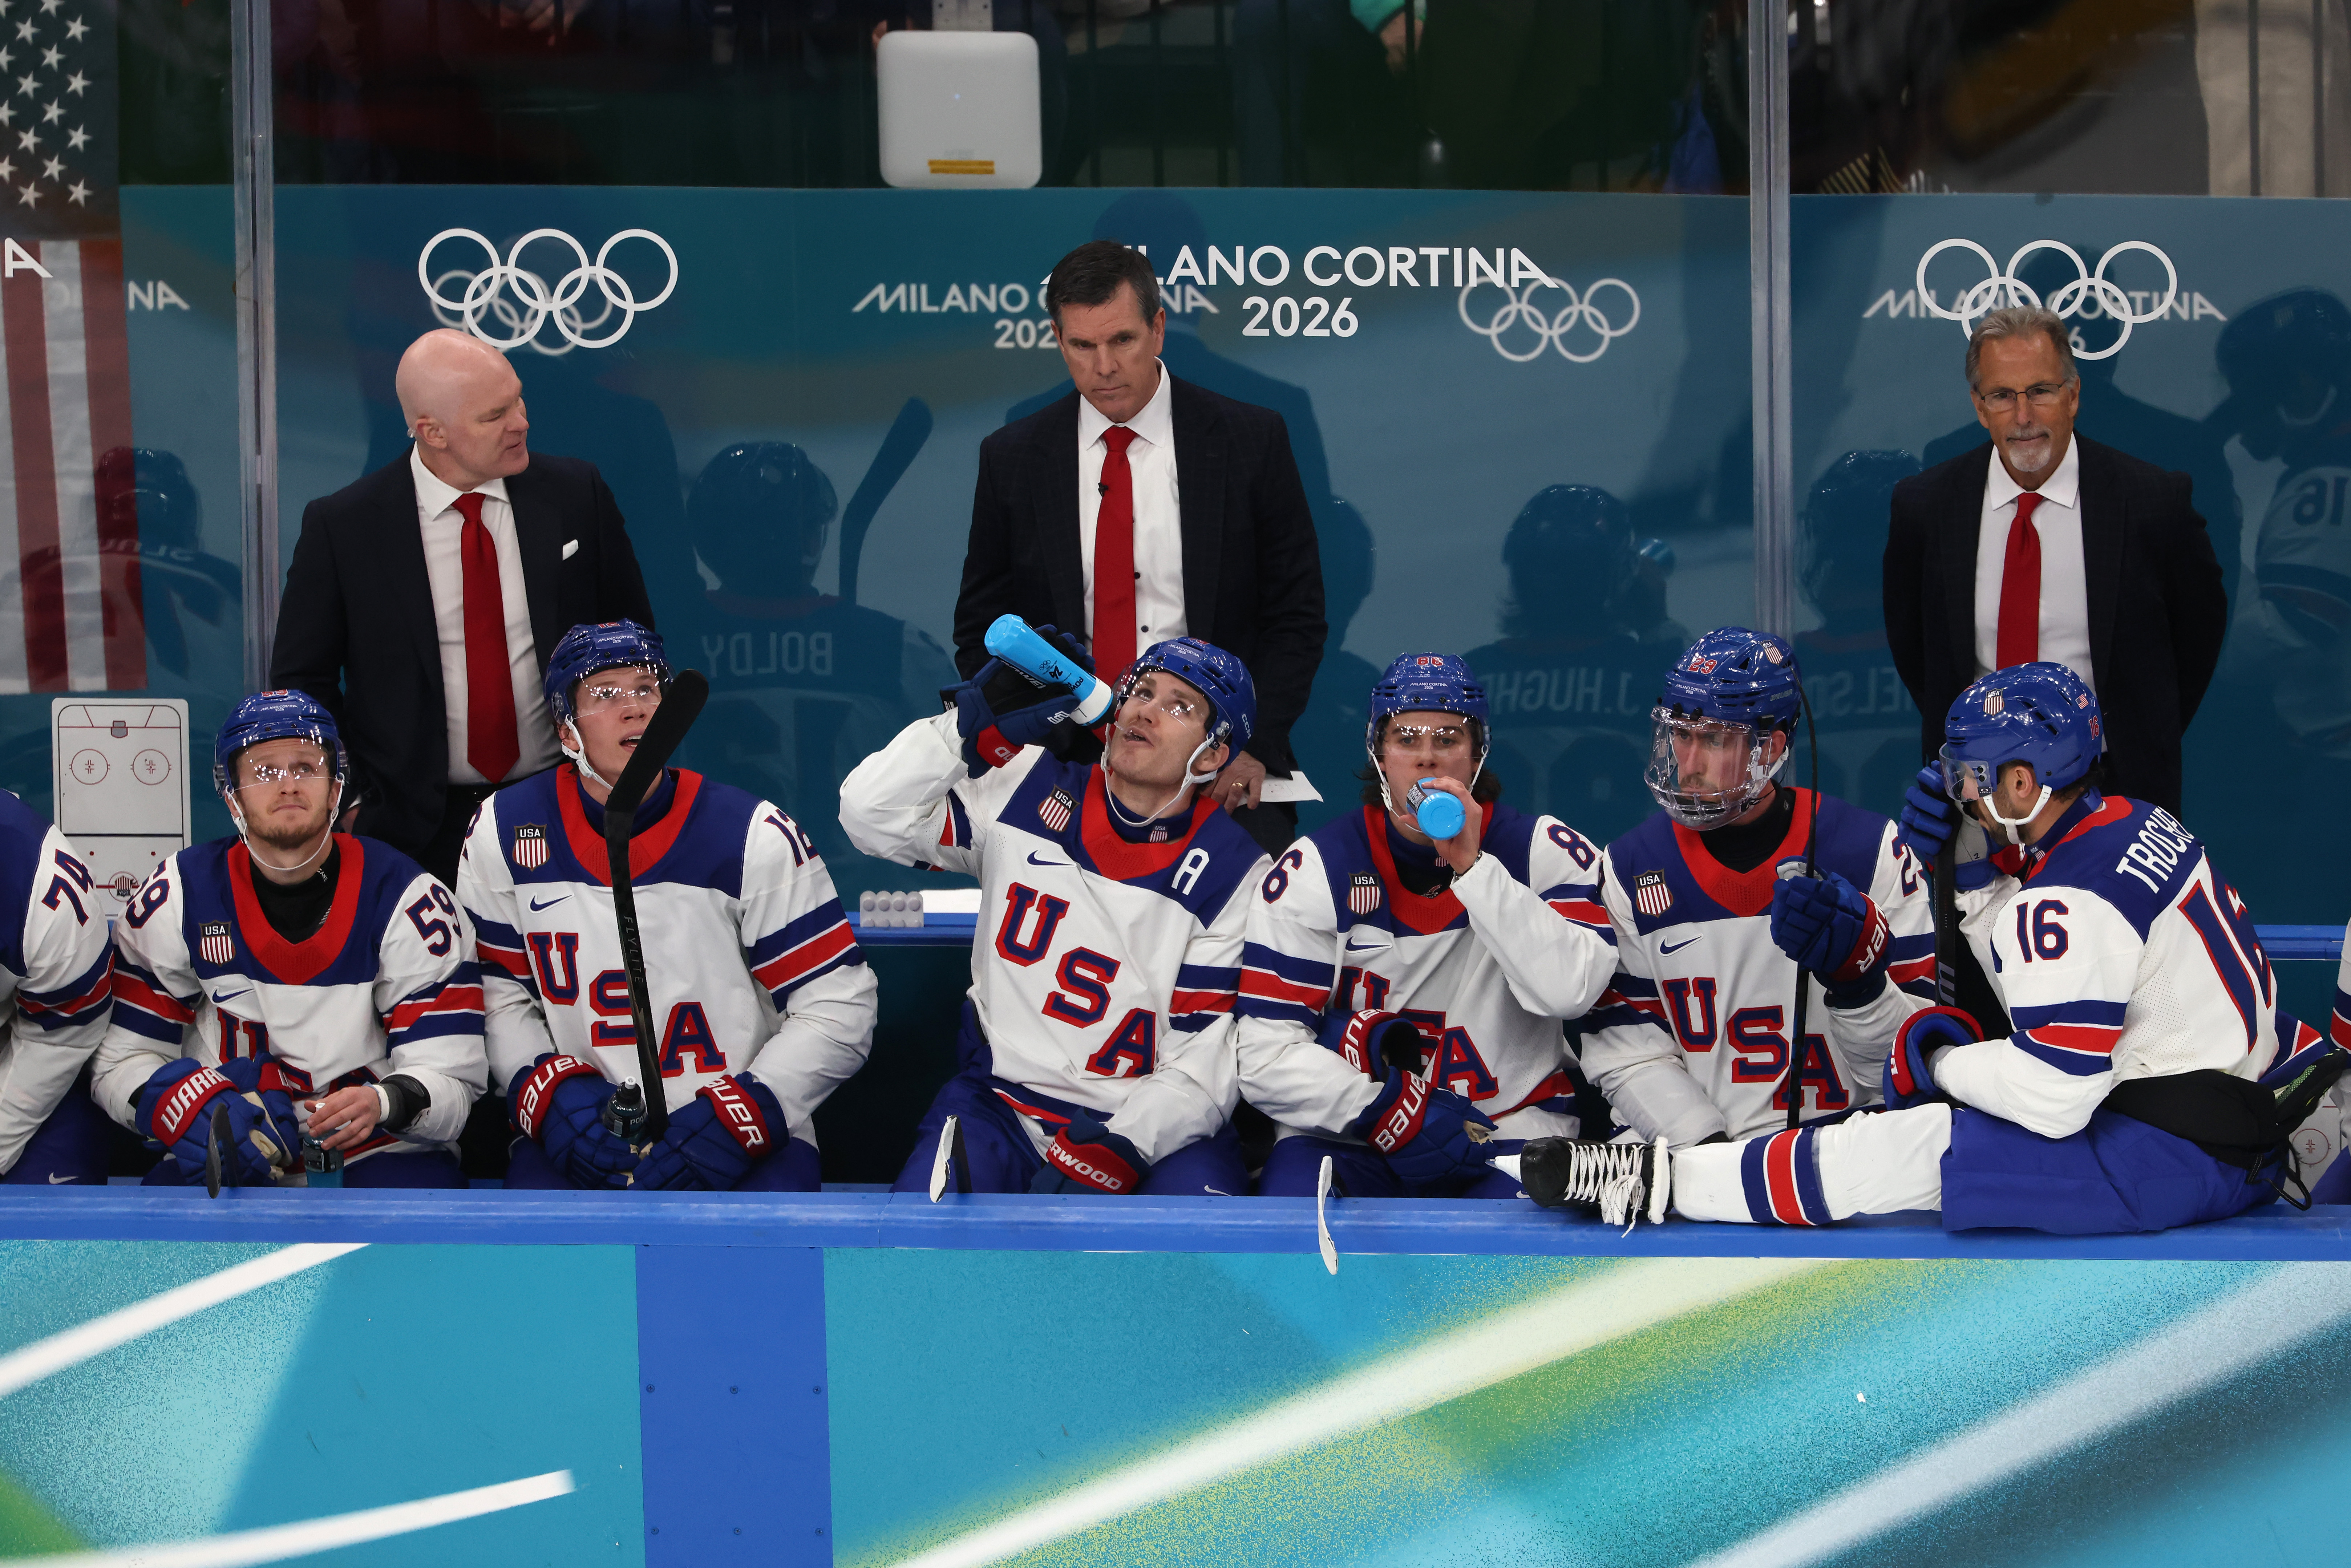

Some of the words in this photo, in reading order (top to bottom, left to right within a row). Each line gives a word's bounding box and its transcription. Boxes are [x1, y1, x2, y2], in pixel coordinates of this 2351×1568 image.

[1303, 245, 1559, 288] CORTINA
[852, 282, 1029, 313] MILANO
[1242, 297, 1359, 337] 2026
[994, 320, 1057, 349] 202
[1417, 656, 1444, 666] 86
[1687, 657, 1717, 674] 29
[1690, 685, 1707, 694] CORTINA
[1242, 713, 1251, 739] CCM
[2088, 715, 2099, 740] 16
[1055, 790, 1073, 809] USA
[520, 828, 540, 838] USA
[2115, 806, 2194, 894] TROCHE
[1170, 847, 1210, 896] A
[1354, 875, 1375, 886] USA
[1639, 875, 1660, 886] USA
[41, 848, 94, 927] 74
[205, 925, 226, 935] USA
[405, 883, 462, 957] 59
[2016, 899, 2068, 963] 16
[624, 916, 643, 983] FLYLITE
[995, 882, 1156, 1077] USA
[527, 932, 728, 1078] USA
[1663, 977, 1848, 1110] USA
